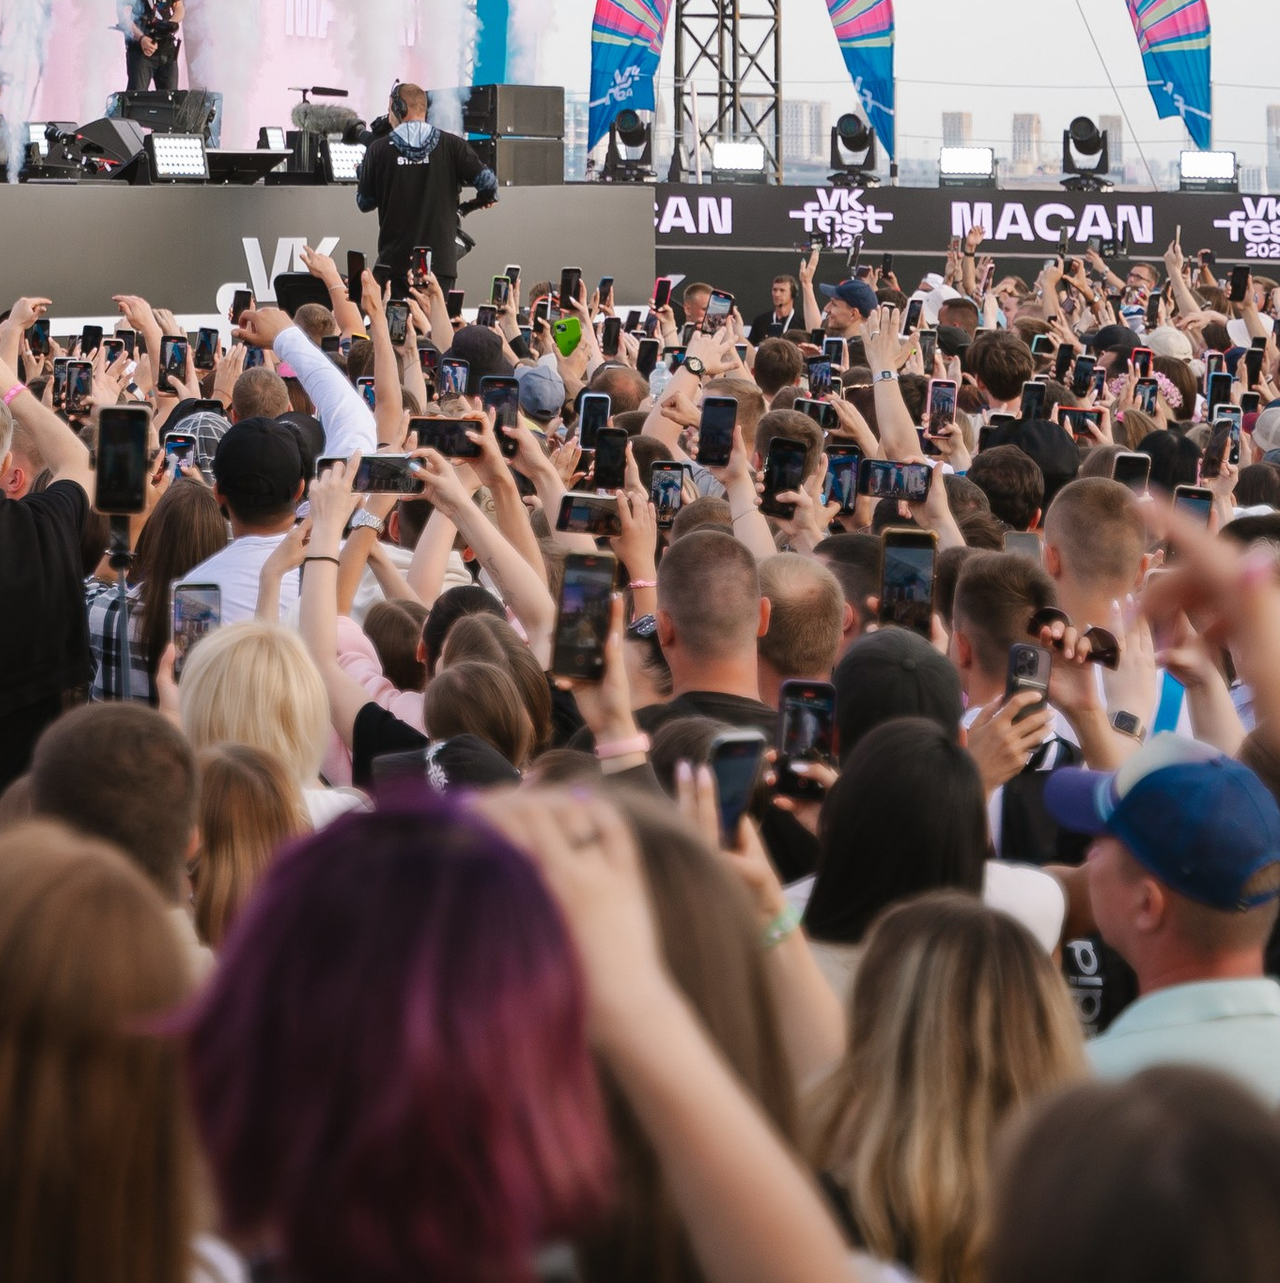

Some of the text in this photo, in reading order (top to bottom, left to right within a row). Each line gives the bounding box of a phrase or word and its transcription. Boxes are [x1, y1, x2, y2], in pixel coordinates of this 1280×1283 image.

[816, 188, 865, 211] VK
[950, 201, 1154, 244] MACAN
[1246, 243, 1280, 258] 202
